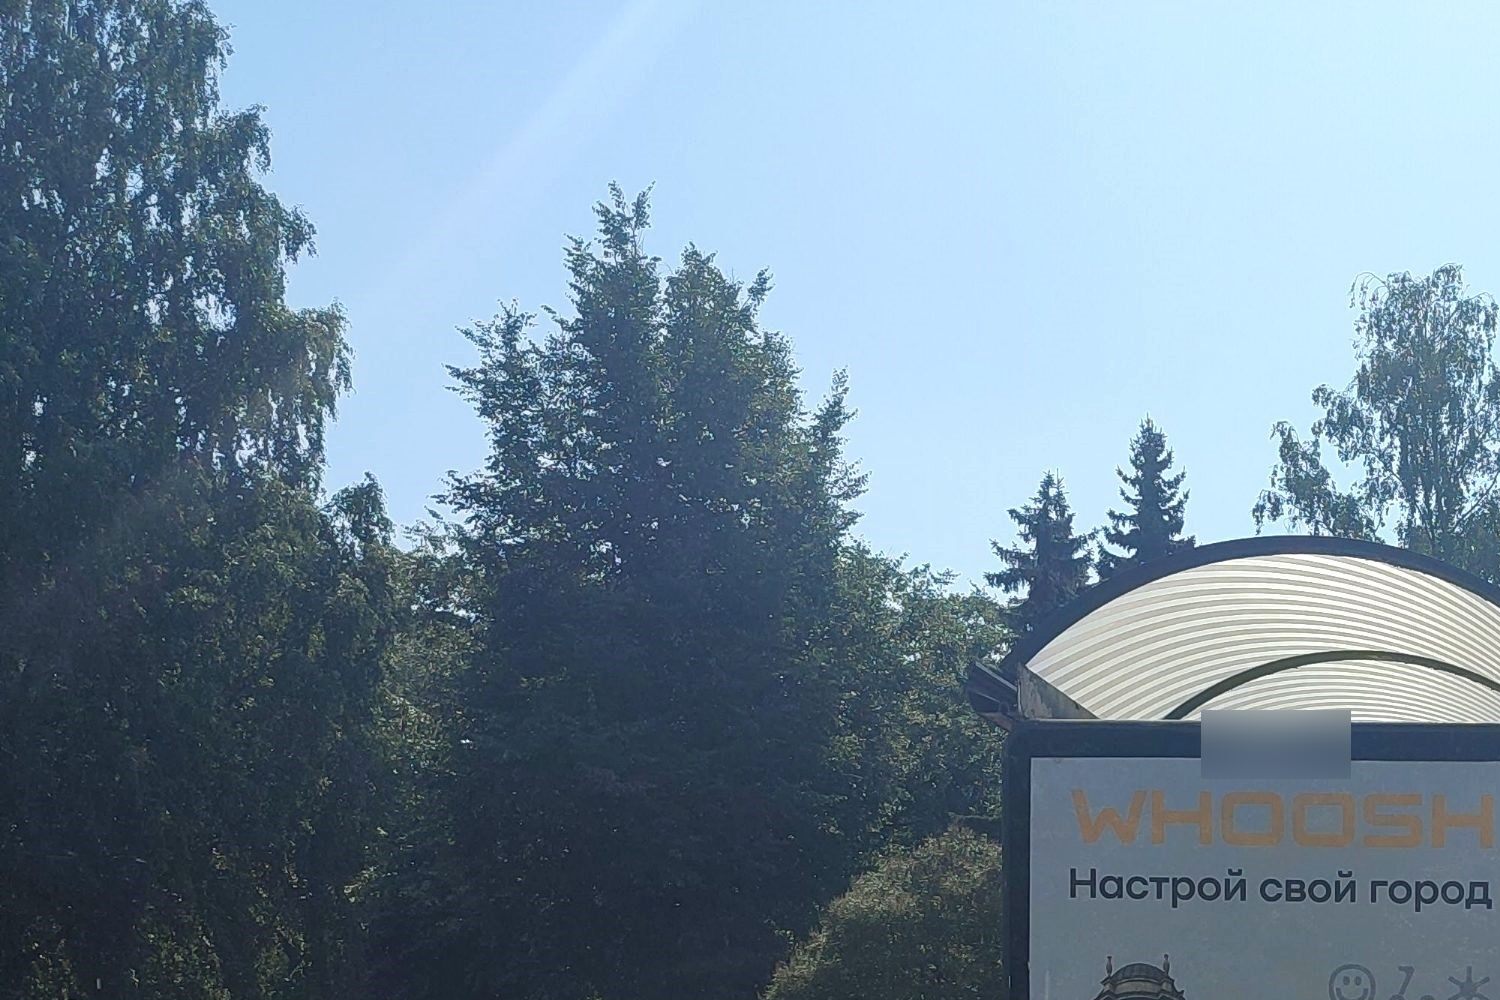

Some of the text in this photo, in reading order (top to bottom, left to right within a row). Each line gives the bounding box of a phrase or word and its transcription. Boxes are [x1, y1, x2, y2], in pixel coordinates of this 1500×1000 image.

[1071, 789, 1495, 848] WHOOSH
[1069, 867, 1493, 913] Настрой свой город
